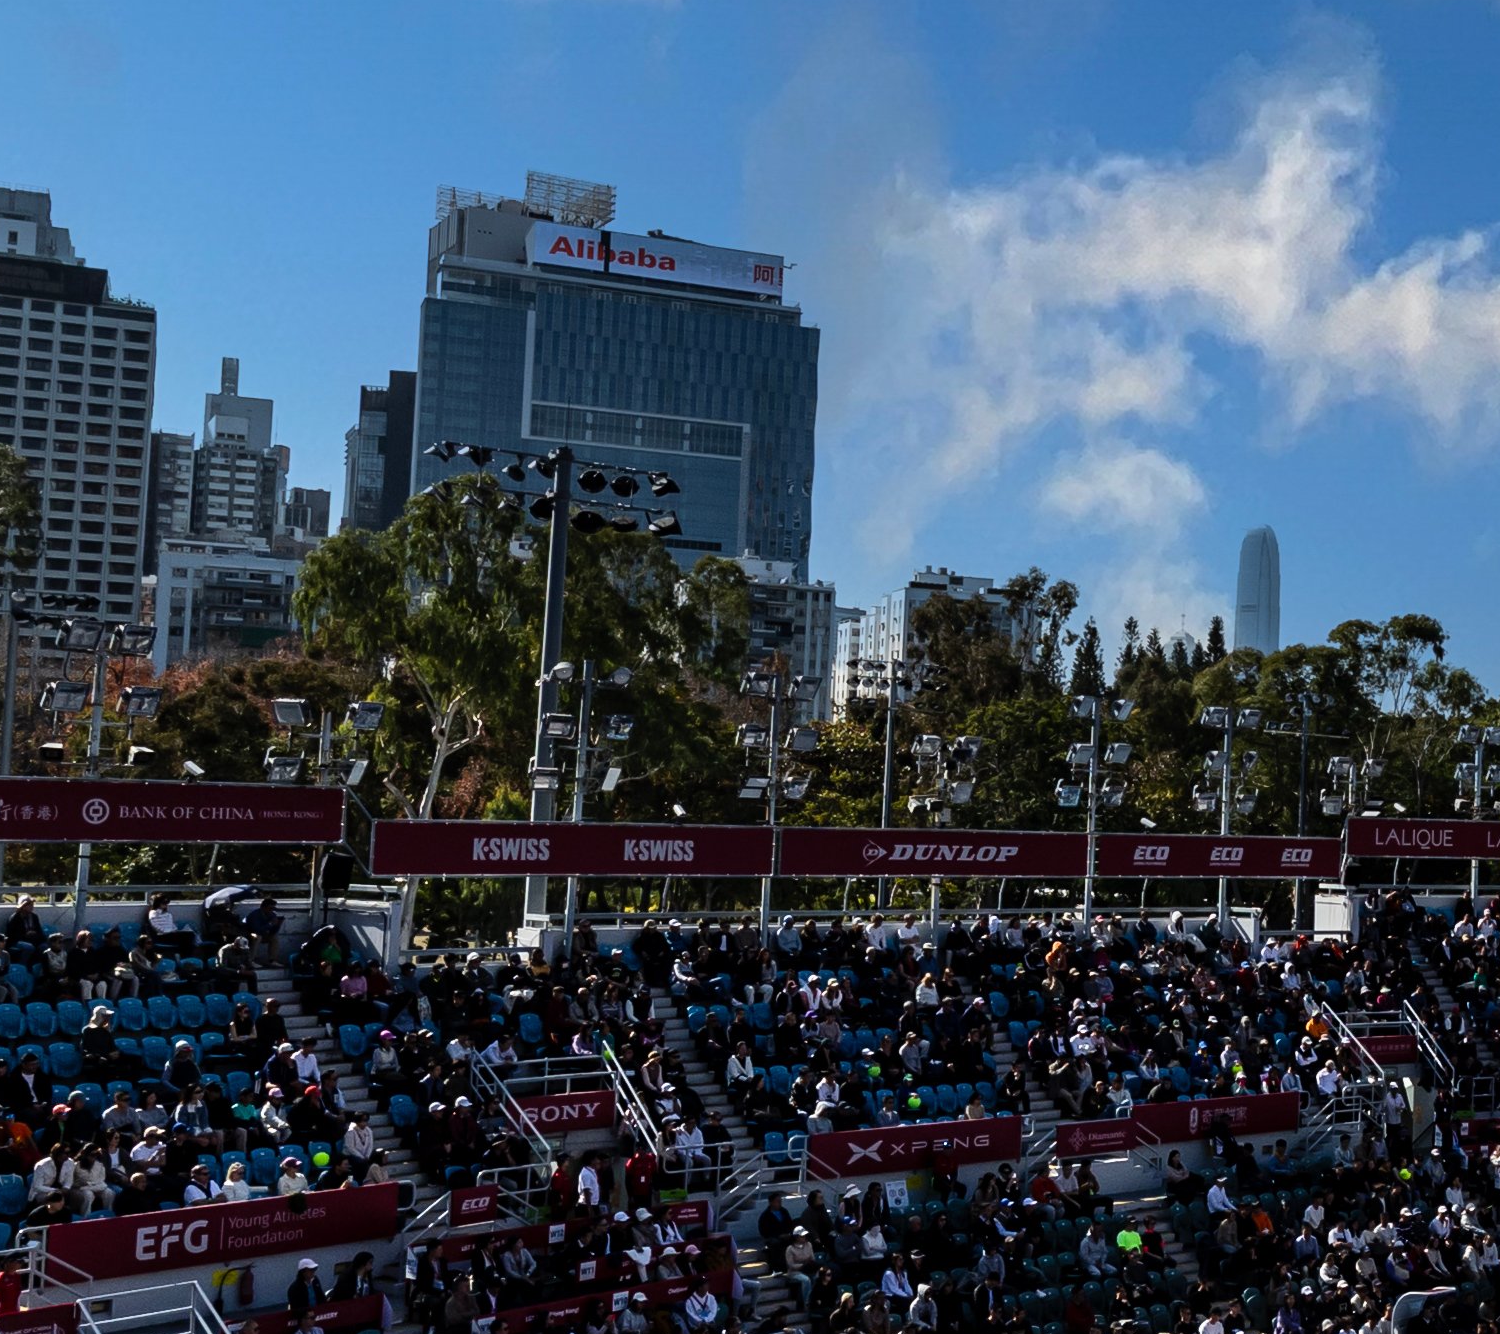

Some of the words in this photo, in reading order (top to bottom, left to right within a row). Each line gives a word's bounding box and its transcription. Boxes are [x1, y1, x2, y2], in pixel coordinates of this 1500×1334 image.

[549, 236, 676, 272] Alibaba
[119, 805, 169, 819] BANK
[172, 805, 197, 819] OF
[201, 806, 254, 820] CHINA
[1375, 828, 1454, 850] LALIQUE
[889, 844, 1020, 862] DUNLOP
[1134, 846, 1171, 861] ECO
[1210, 847, 1244, 861] ECO
[1281, 848, 1312, 863] ECO
[523, 1102, 602, 1125] SONY
[890, 1135, 990, 1156] XPENG
[461, 1196, 491, 1211] ECO
[228, 1214, 269, 1231] Young
[135, 1219, 209, 1261] EFG
[227, 1228, 304, 1250] Foundation
